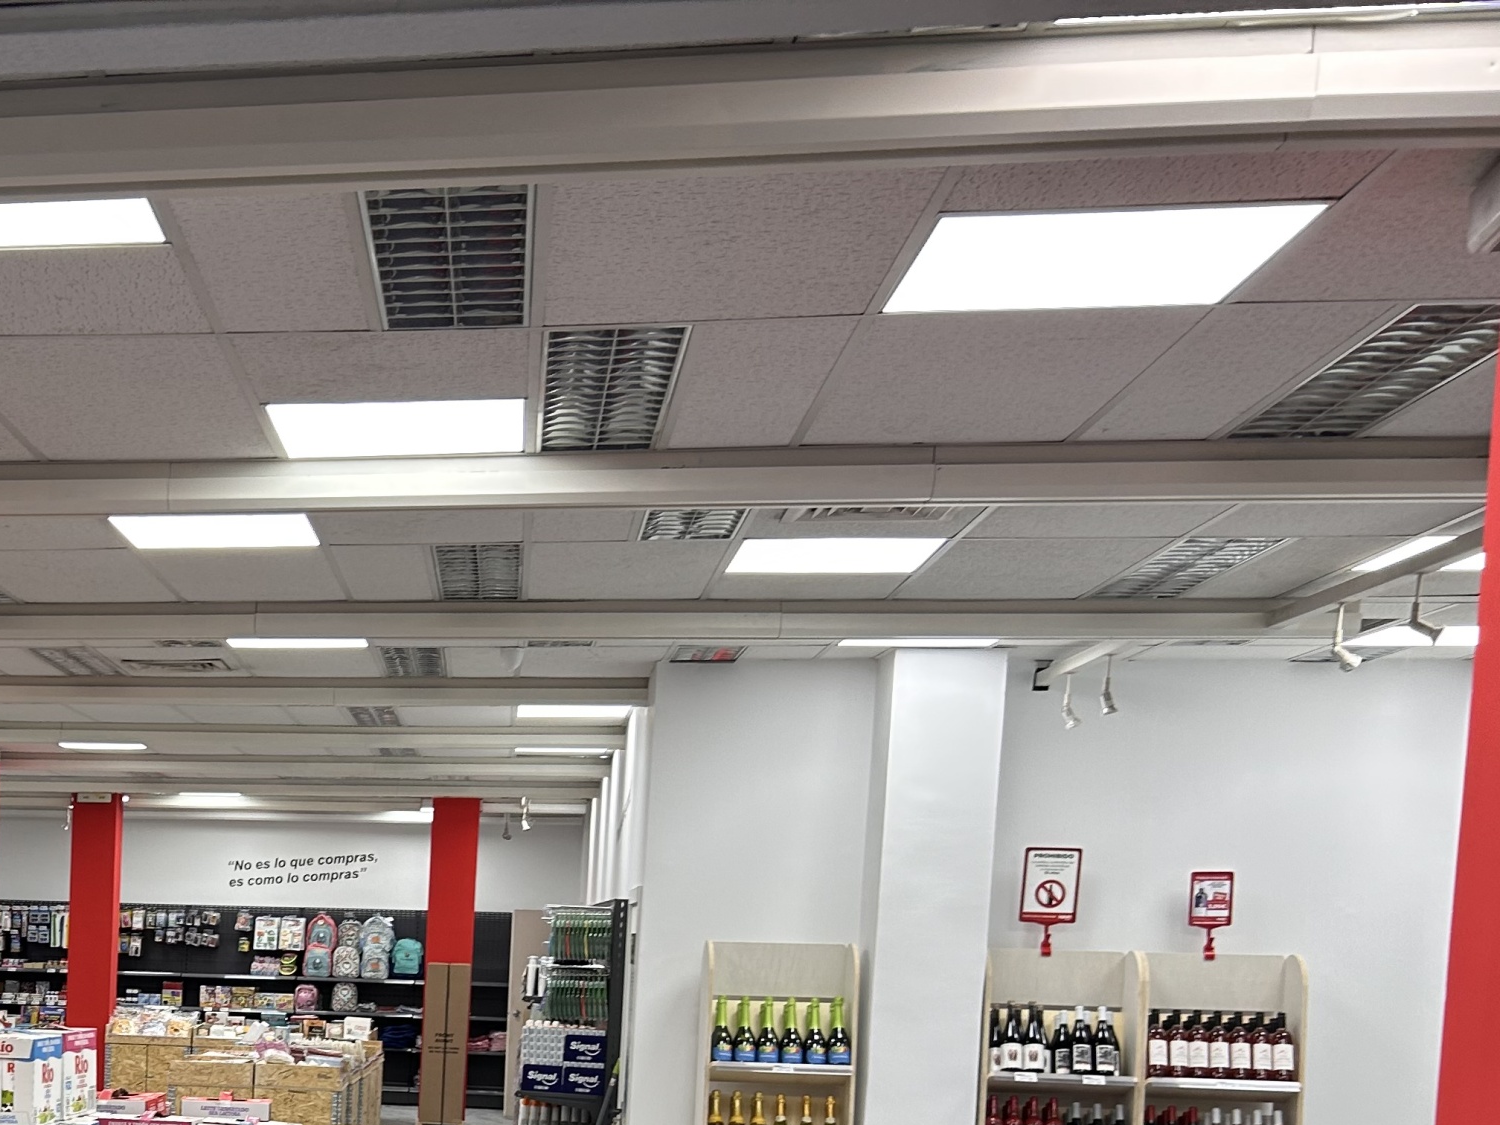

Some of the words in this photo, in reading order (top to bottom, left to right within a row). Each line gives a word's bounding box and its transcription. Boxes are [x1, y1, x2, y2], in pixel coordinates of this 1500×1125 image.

[256, 860, 270, 870] es
[274, 857, 286, 868] lo
[290, 857, 314, 870] que
[317, 853, 378, 866] compras,
[229, 877, 244, 887] es
[247, 875, 283, 886] como
[287, 873, 299, 884] lo
[302, 867, 367, 883] compras”
[570, 1041, 601, 1051] Signal
[75, 1054, 89, 1074] Río
[42, 1063, 54, 1083] Río
[527, 1070, 557, 1081] Signal
[568, 1073, 599, 1084] Signal
